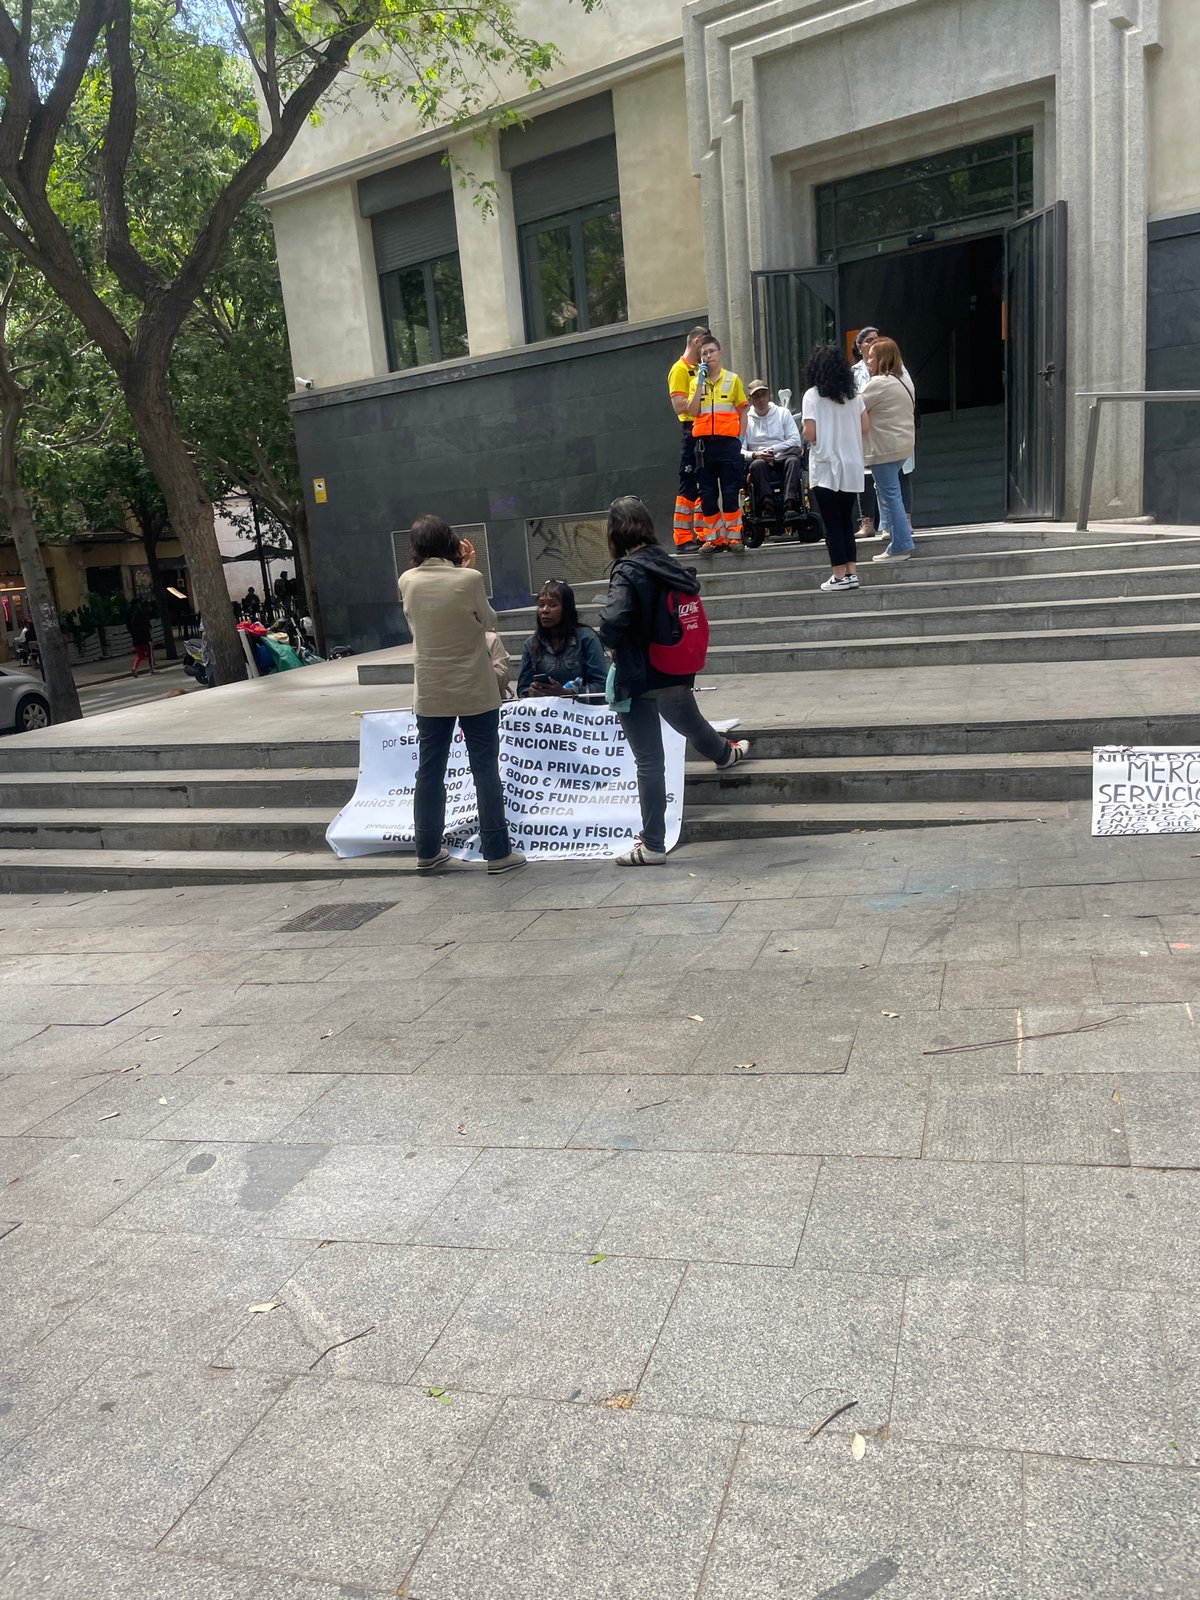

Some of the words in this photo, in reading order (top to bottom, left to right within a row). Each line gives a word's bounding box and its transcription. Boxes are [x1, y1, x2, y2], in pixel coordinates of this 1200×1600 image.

[541, 707, 558, 718] de
[563, 711, 621, 726] MENORE
[382, 737, 398, 750] por
[535, 722, 608, 741] SABADELL
[582, 746, 600, 756] de
[605, 747, 625, 757] UE
[499, 753, 543, 771] OGIDA
[547, 761, 621, 777] PRIVADOS
[1127, 761, 1200, 784] MERC
[506, 768, 538, 786] 8000
[354, 798, 395, 808] NIÑOS
[573, 828, 582, 839] y
